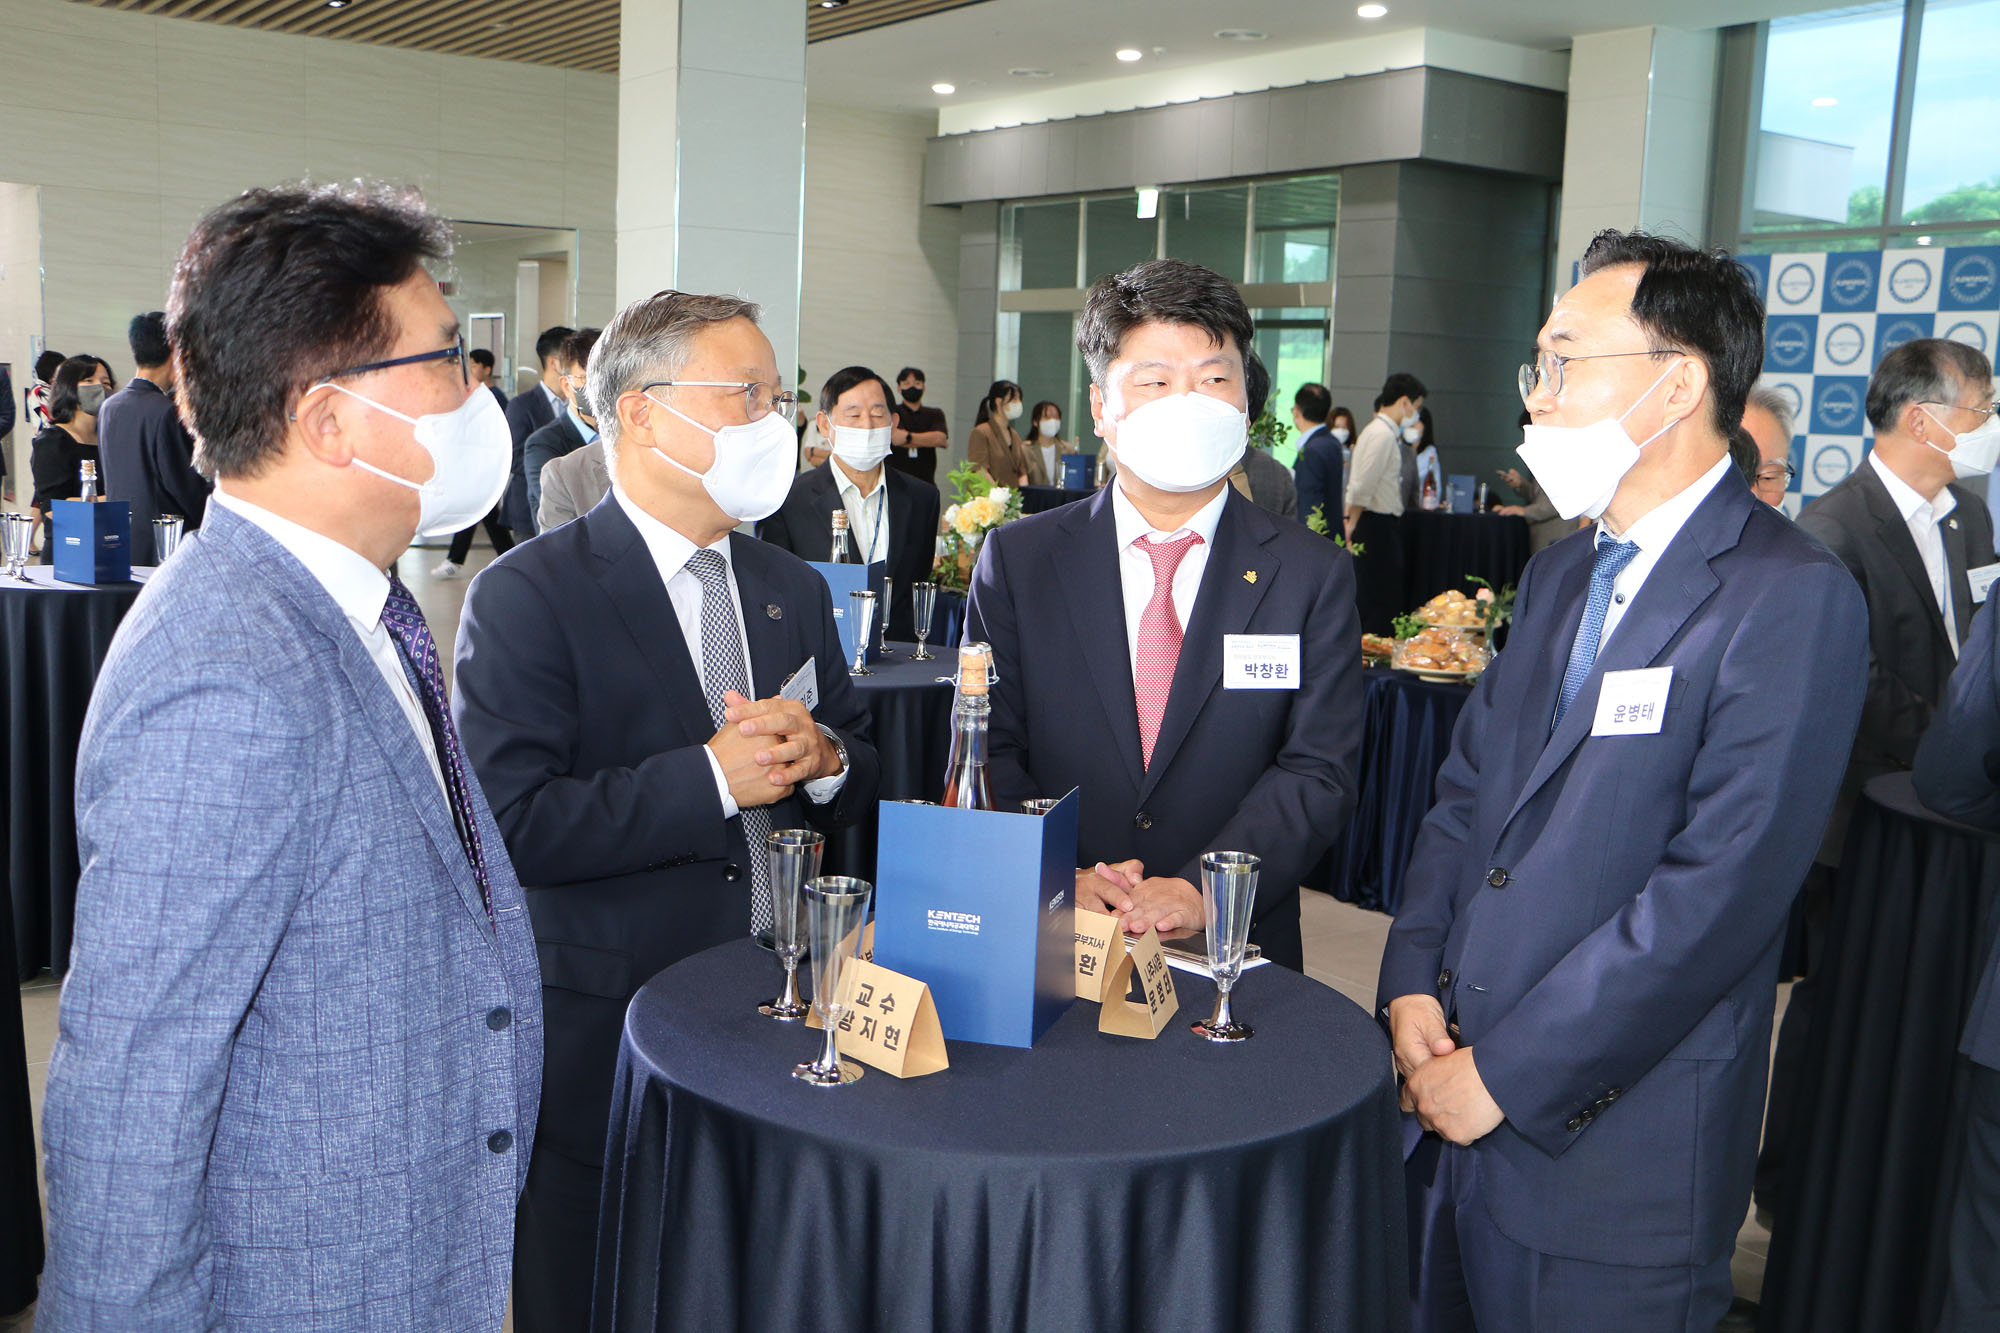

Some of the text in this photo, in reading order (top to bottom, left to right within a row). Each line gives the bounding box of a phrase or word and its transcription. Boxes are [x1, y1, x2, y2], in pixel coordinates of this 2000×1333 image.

[1244, 663, 1288, 679] 박창환
[1613, 702, 1655, 723] 윤병태
[927, 909, 981, 924] KENTECH
[1079, 953, 1097, 977] 환
